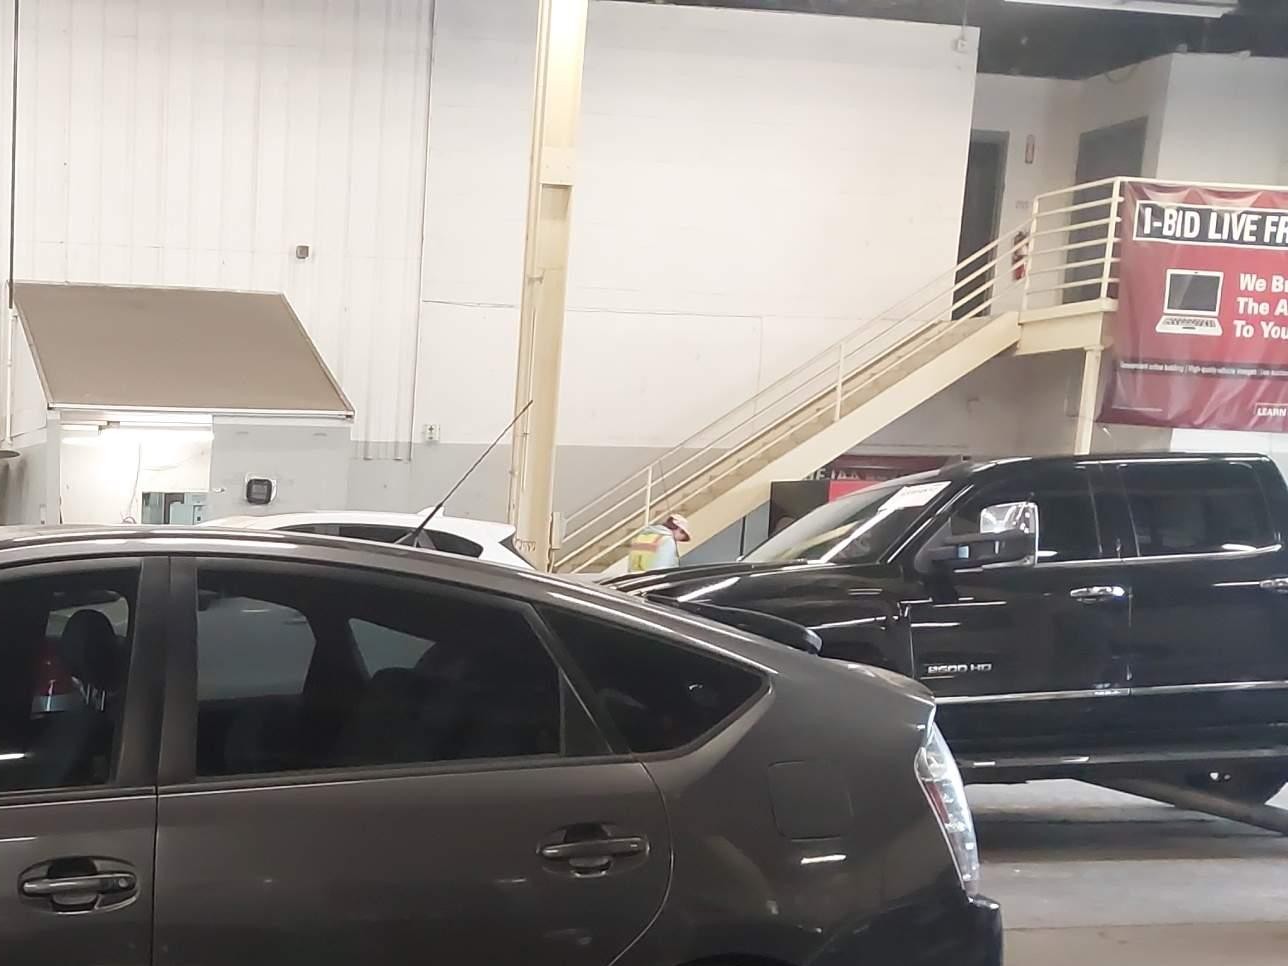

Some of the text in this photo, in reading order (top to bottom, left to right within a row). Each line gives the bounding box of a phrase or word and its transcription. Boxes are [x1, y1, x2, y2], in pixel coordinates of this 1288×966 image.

[1143, 206, 1201, 239] I-BID
[1207, 211, 1262, 242] LIVE
[1239, 273, 1267, 292] We
[1237, 297, 1270, 315] The
[1233, 319, 1255, 338] To
[1256, 407, 1287, 417] LEARN
[970, 663, 992, 672] HD
